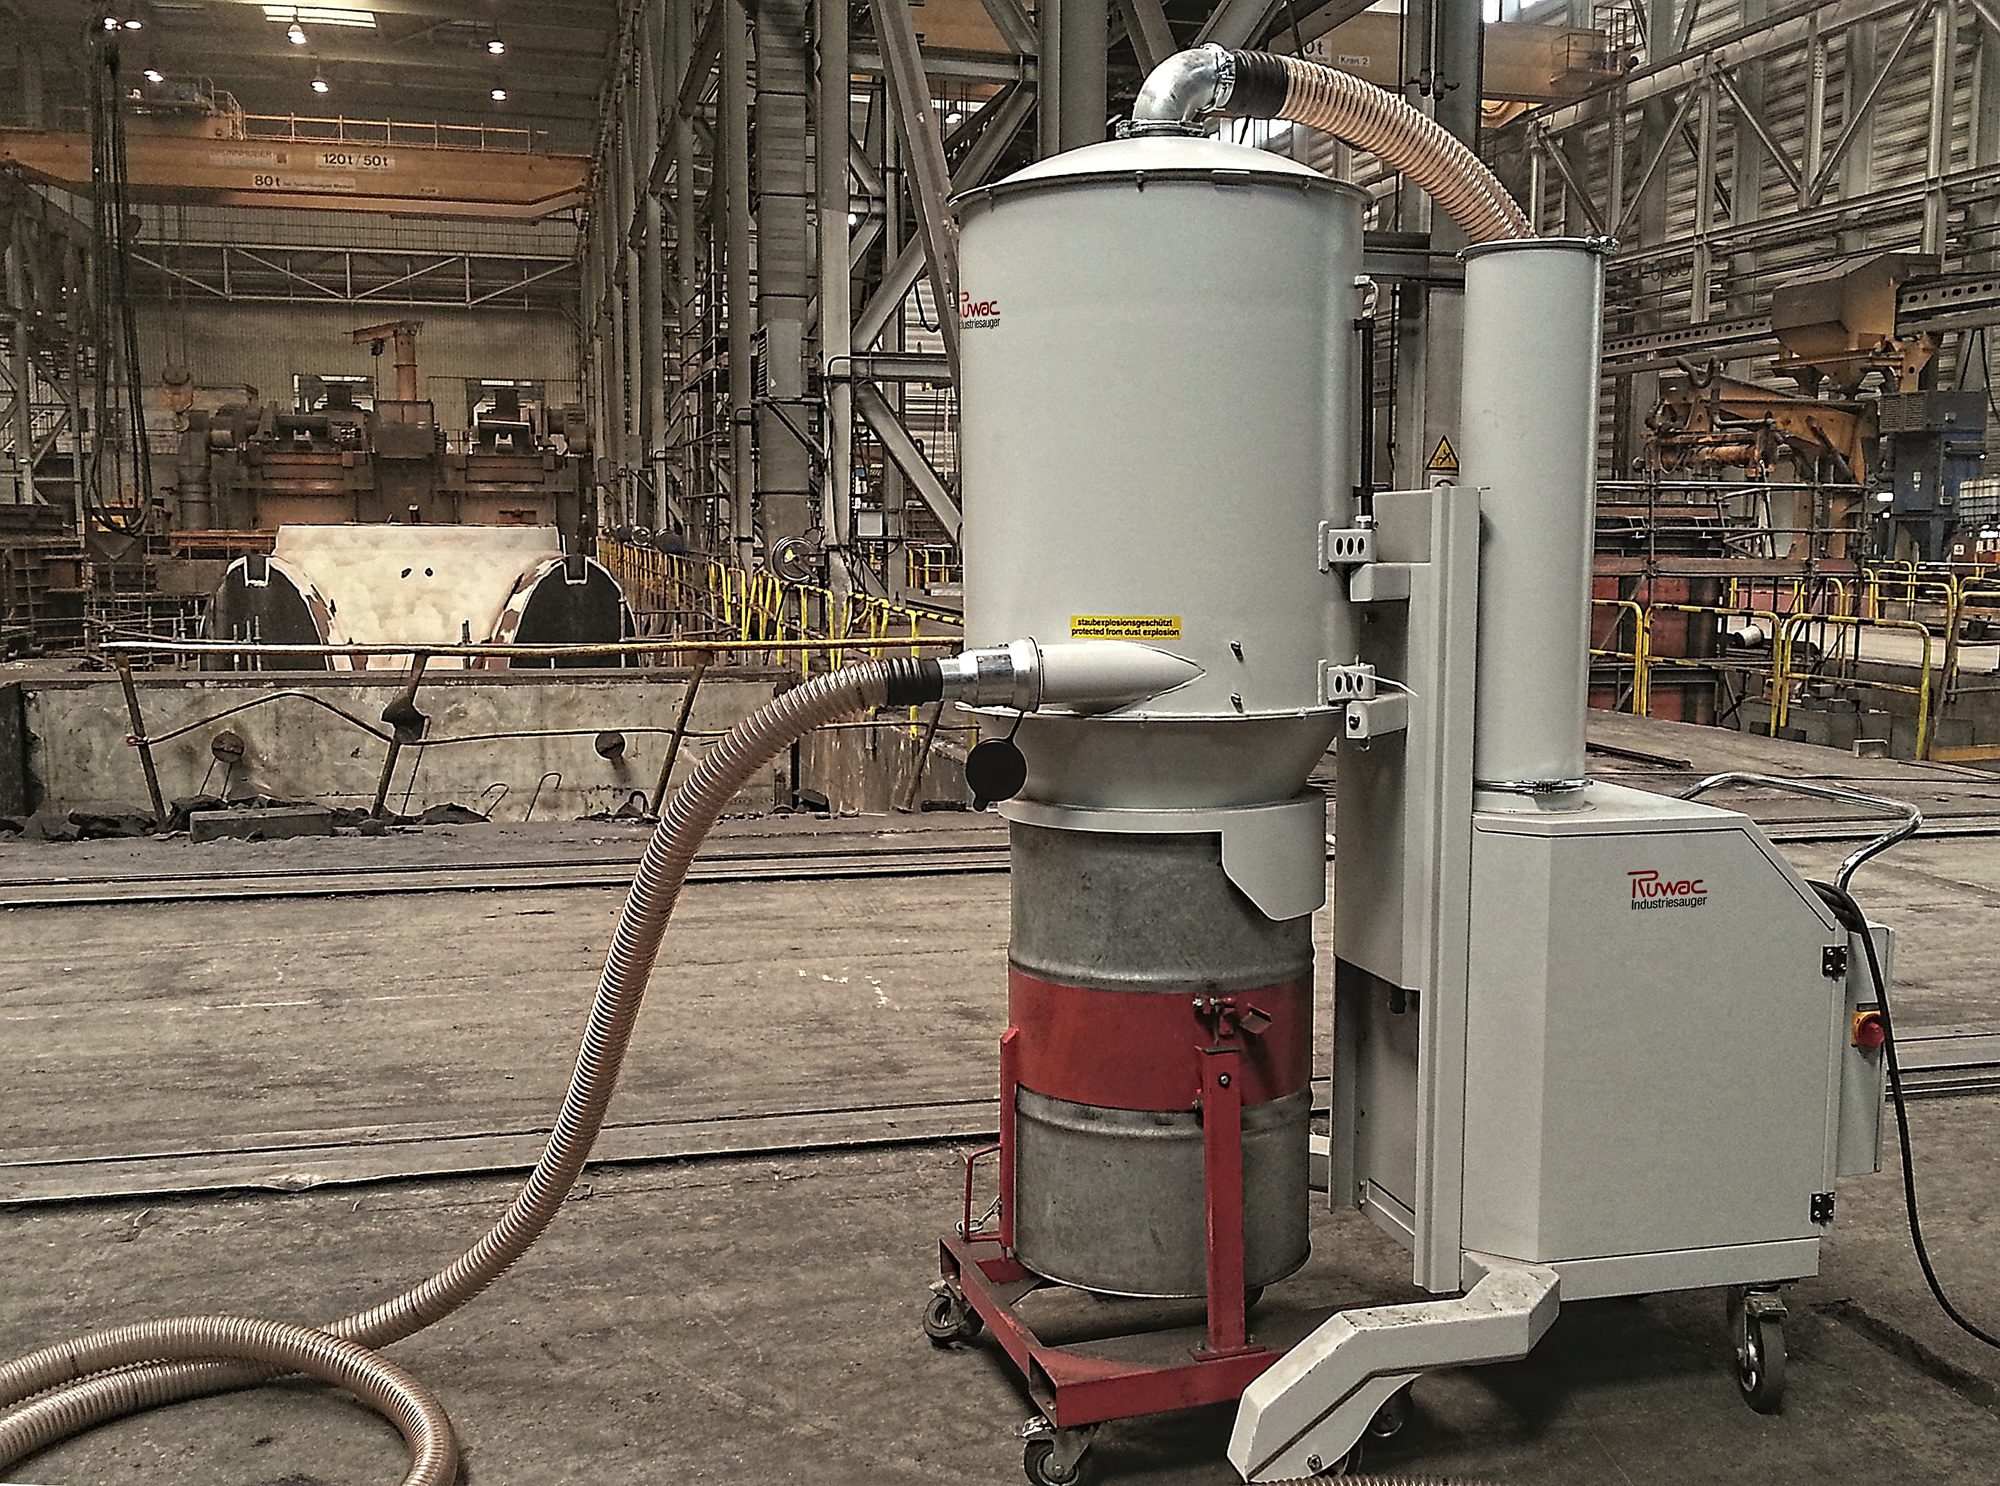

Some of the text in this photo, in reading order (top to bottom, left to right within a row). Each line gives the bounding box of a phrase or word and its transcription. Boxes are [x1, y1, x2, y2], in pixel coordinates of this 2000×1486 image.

[1362, 57, 1369, 65] 2
[1077, 618, 1173, 628] staubexplosionsgeschützt
[1071, 628, 1180, 638] protected from dust explosion
[1627, 870, 1708, 898] Ruwac
[1631, 896, 1708, 910] Industriesauger
